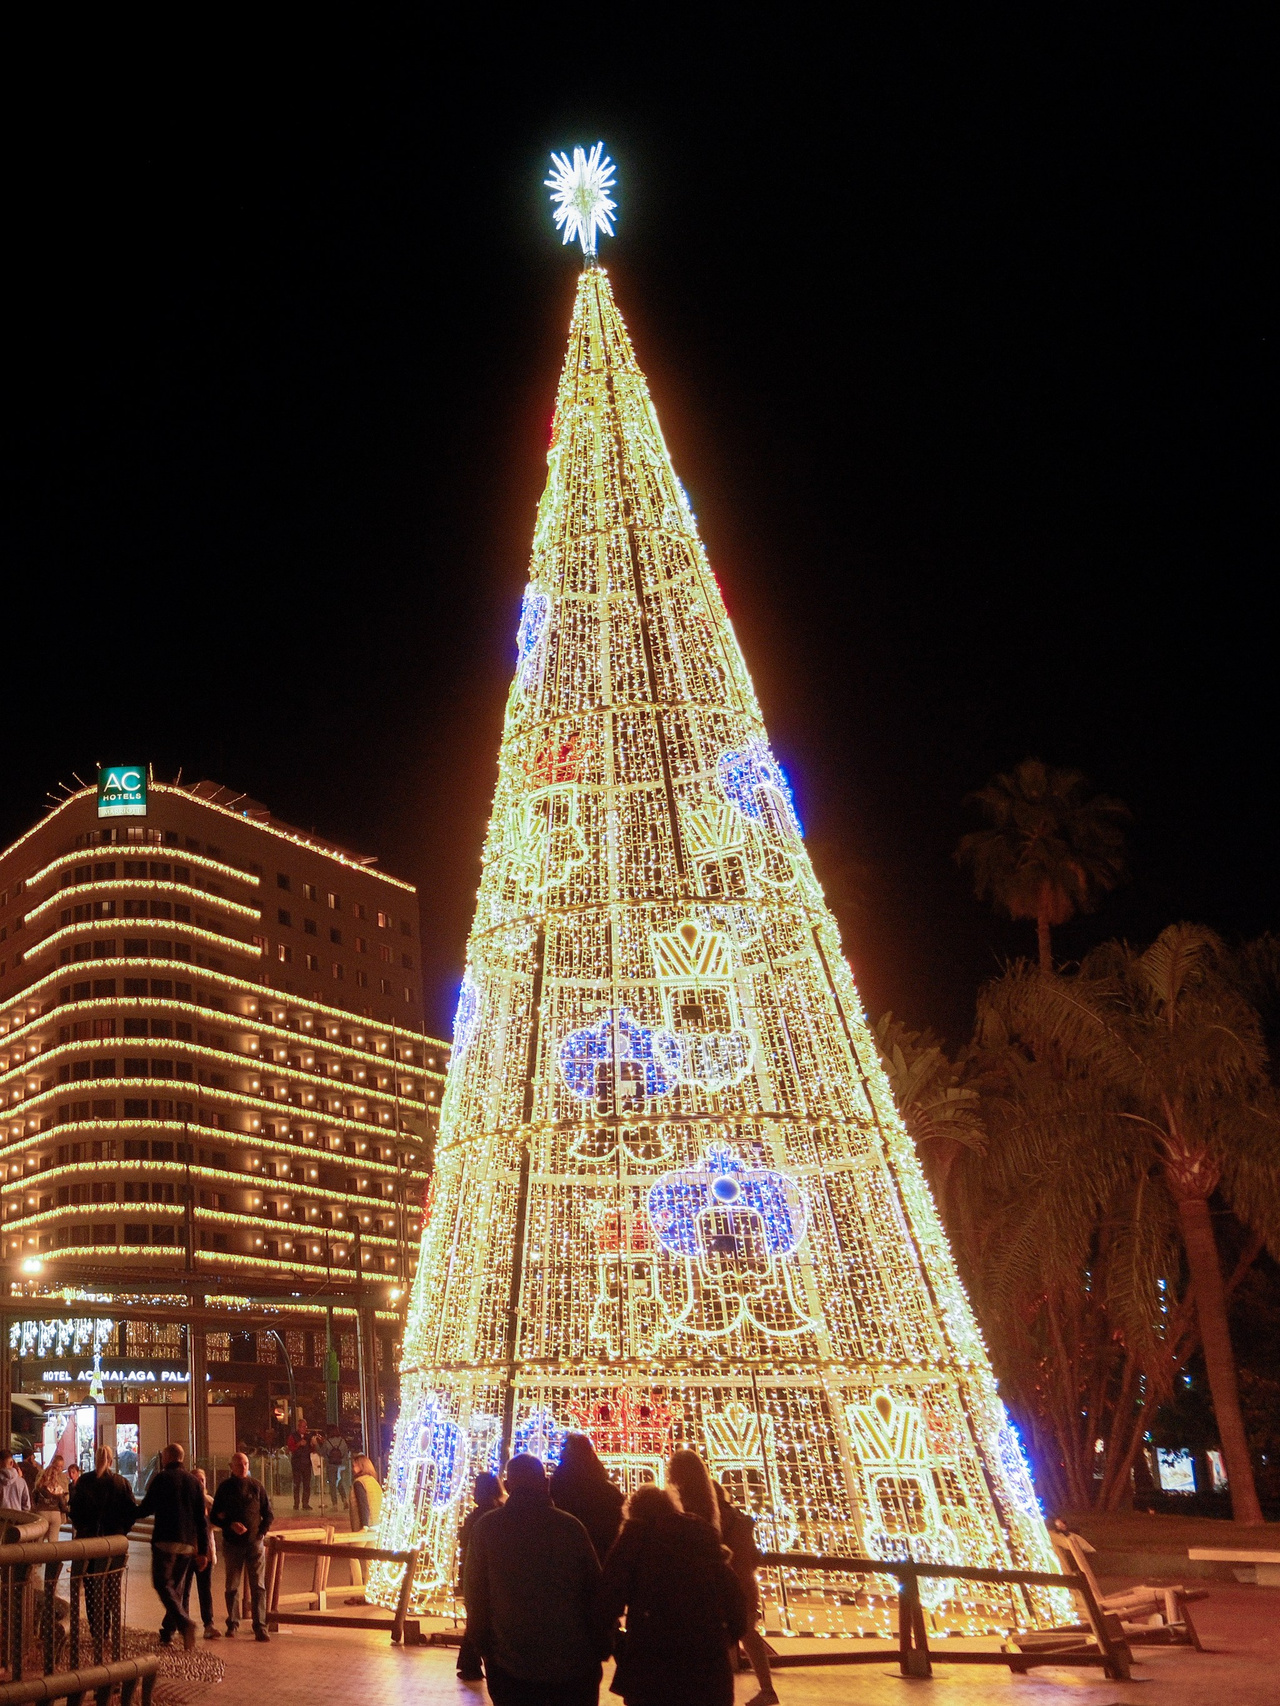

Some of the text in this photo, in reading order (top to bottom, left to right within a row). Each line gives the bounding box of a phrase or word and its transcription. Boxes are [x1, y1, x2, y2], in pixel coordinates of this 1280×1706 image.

[104, 771, 141, 792] AC
[103, 793, 142, 801] HOTELS
[43, 1371, 71, 1381] HOTEL
[77, 1371, 94, 1381] AC
